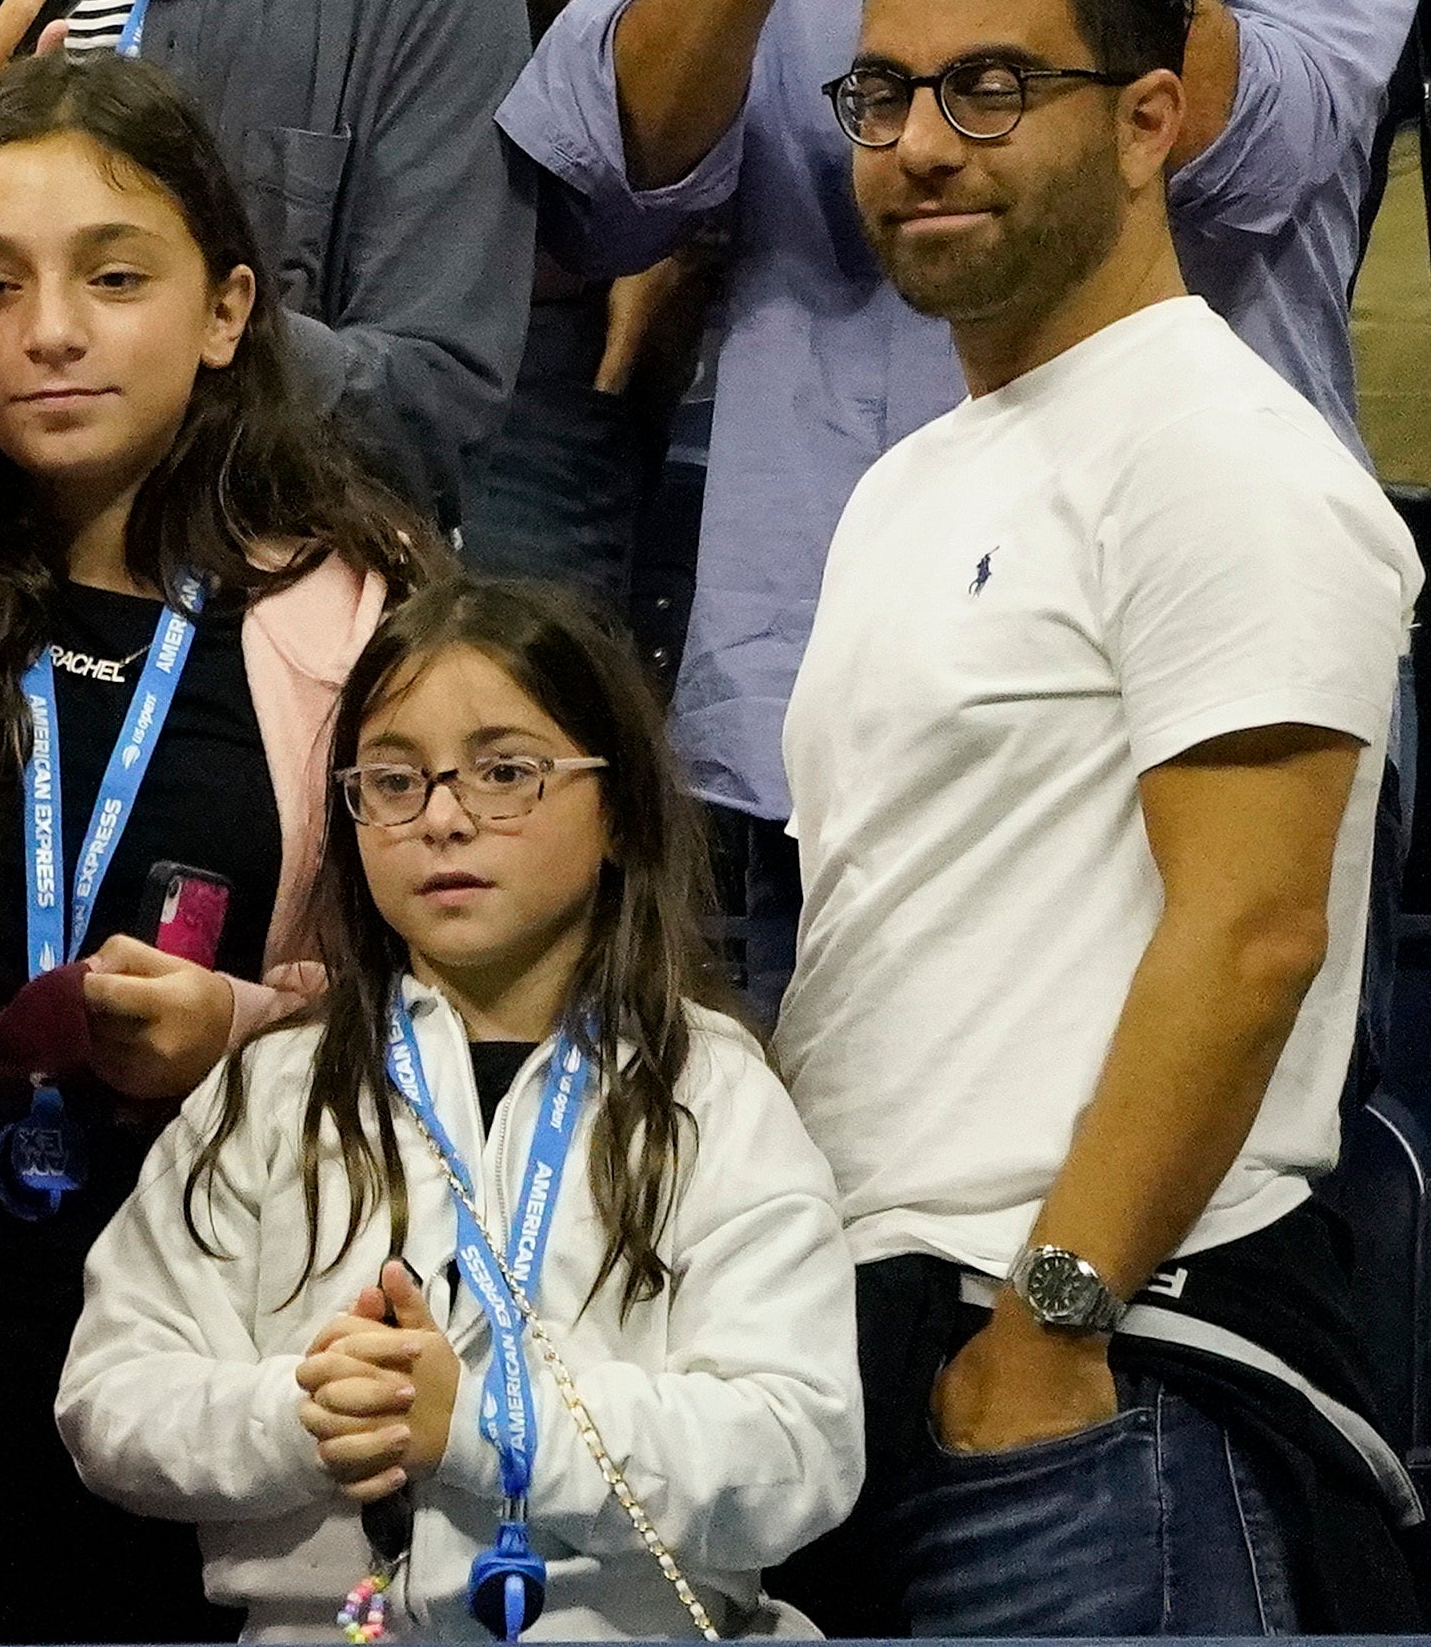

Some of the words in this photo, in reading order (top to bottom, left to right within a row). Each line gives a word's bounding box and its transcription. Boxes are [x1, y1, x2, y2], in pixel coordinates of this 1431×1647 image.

[49, 644, 126, 683] RACHEL
[29, 693, 52, 800] AMERICAN
[132, 731, 145, 745] us
[138, 692, 157, 732] open
[34, 803, 56, 908] EXPRESS
[76, 797, 123, 898] EXPRESS
[550, 1092, 568, 1130] open
[559, 1074, 574, 1094] us
[511, 1159, 554, 1282] AMERICAN
[460, 1244, 513, 1329] EXPRESS
[502, 1334, 526, 1453] AMERICAN
